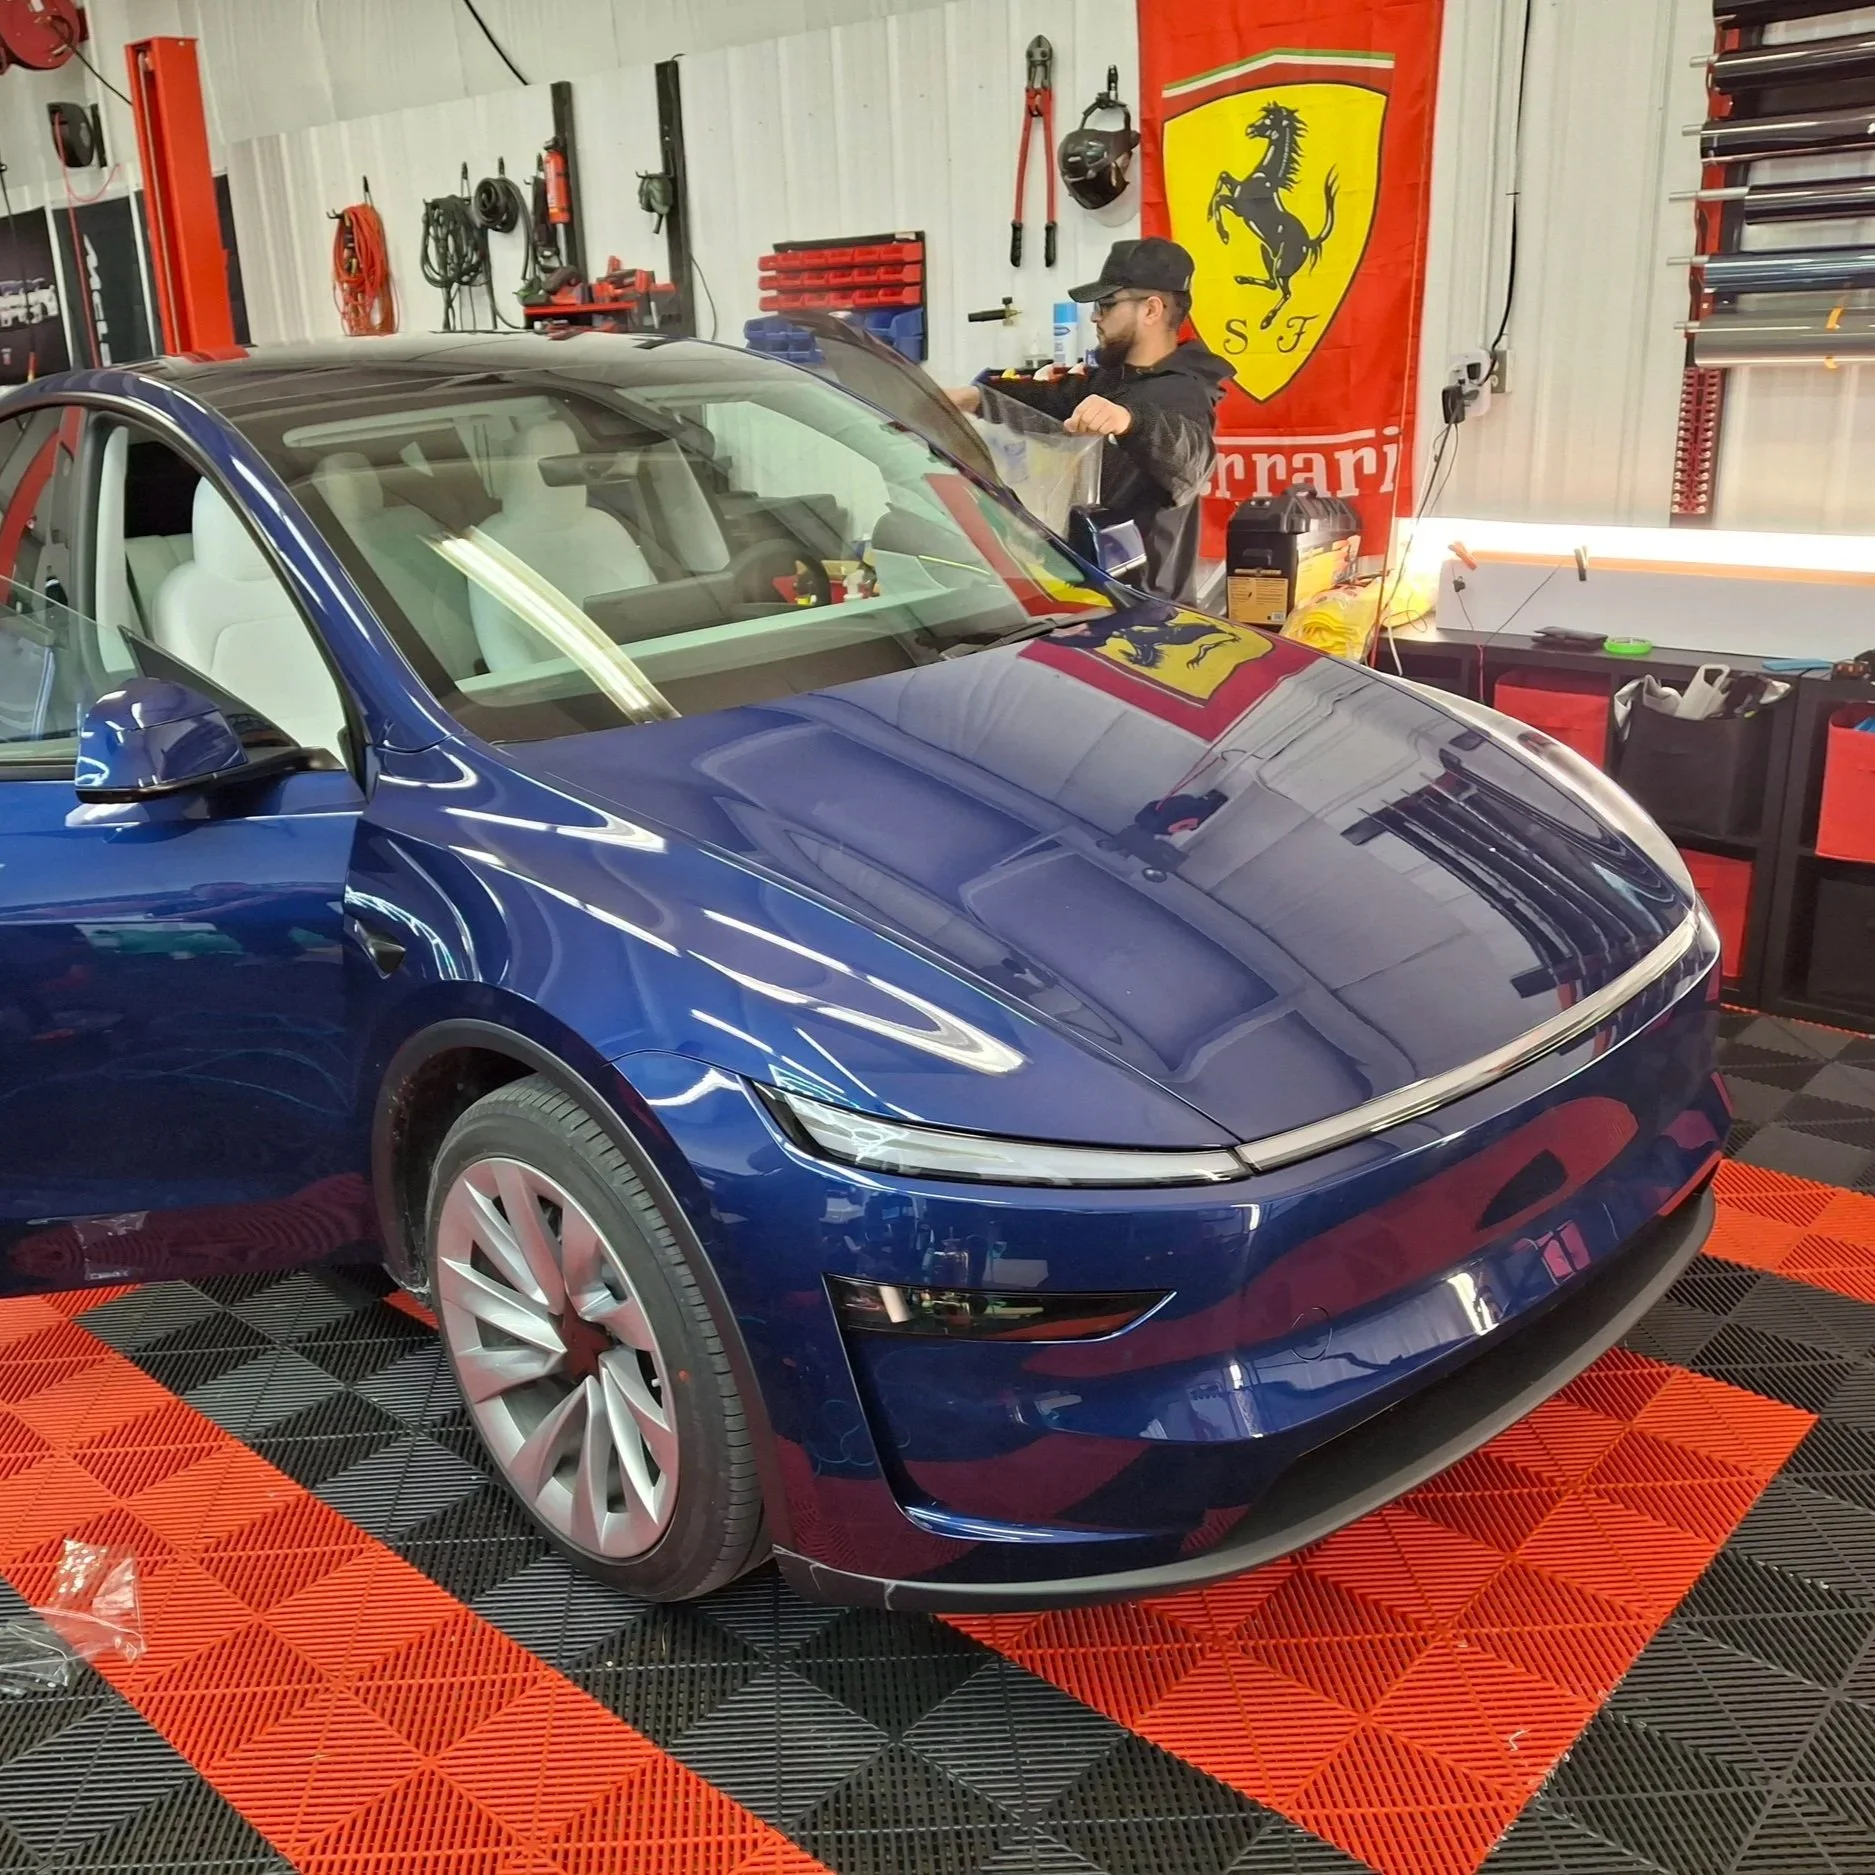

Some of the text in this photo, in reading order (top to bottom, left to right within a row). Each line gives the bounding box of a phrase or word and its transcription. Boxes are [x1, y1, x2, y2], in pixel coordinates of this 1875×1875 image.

[1223, 313, 1319, 355] S F
[1200, 425, 1401, 498] rrari
